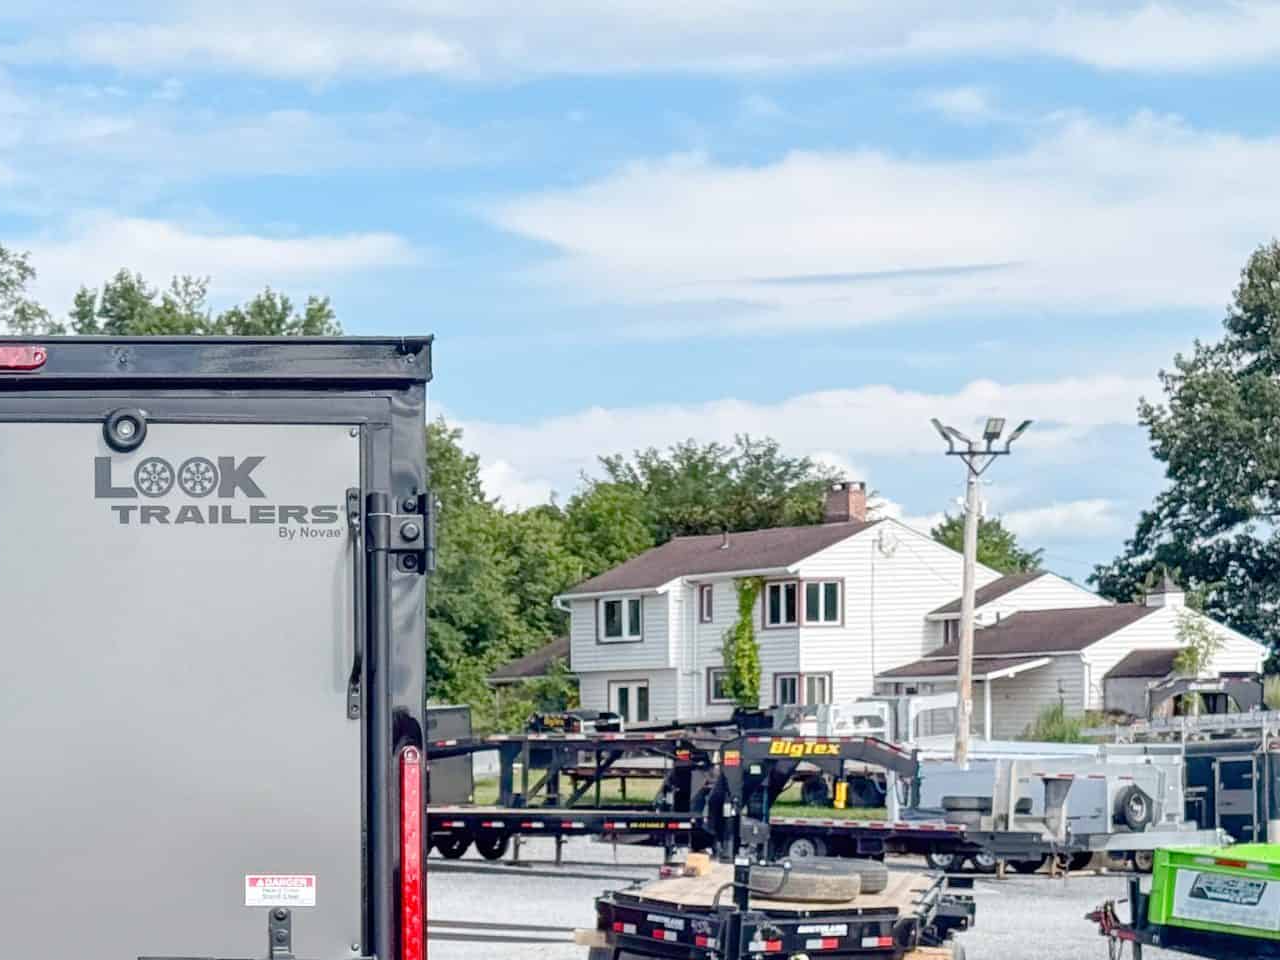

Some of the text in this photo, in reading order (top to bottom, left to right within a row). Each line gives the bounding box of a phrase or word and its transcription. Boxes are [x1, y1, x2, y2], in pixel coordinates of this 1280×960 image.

[94, 456, 266, 498] LOOK
[111, 505, 339, 524] TRAILERS
[279, 526, 296, 540] By
